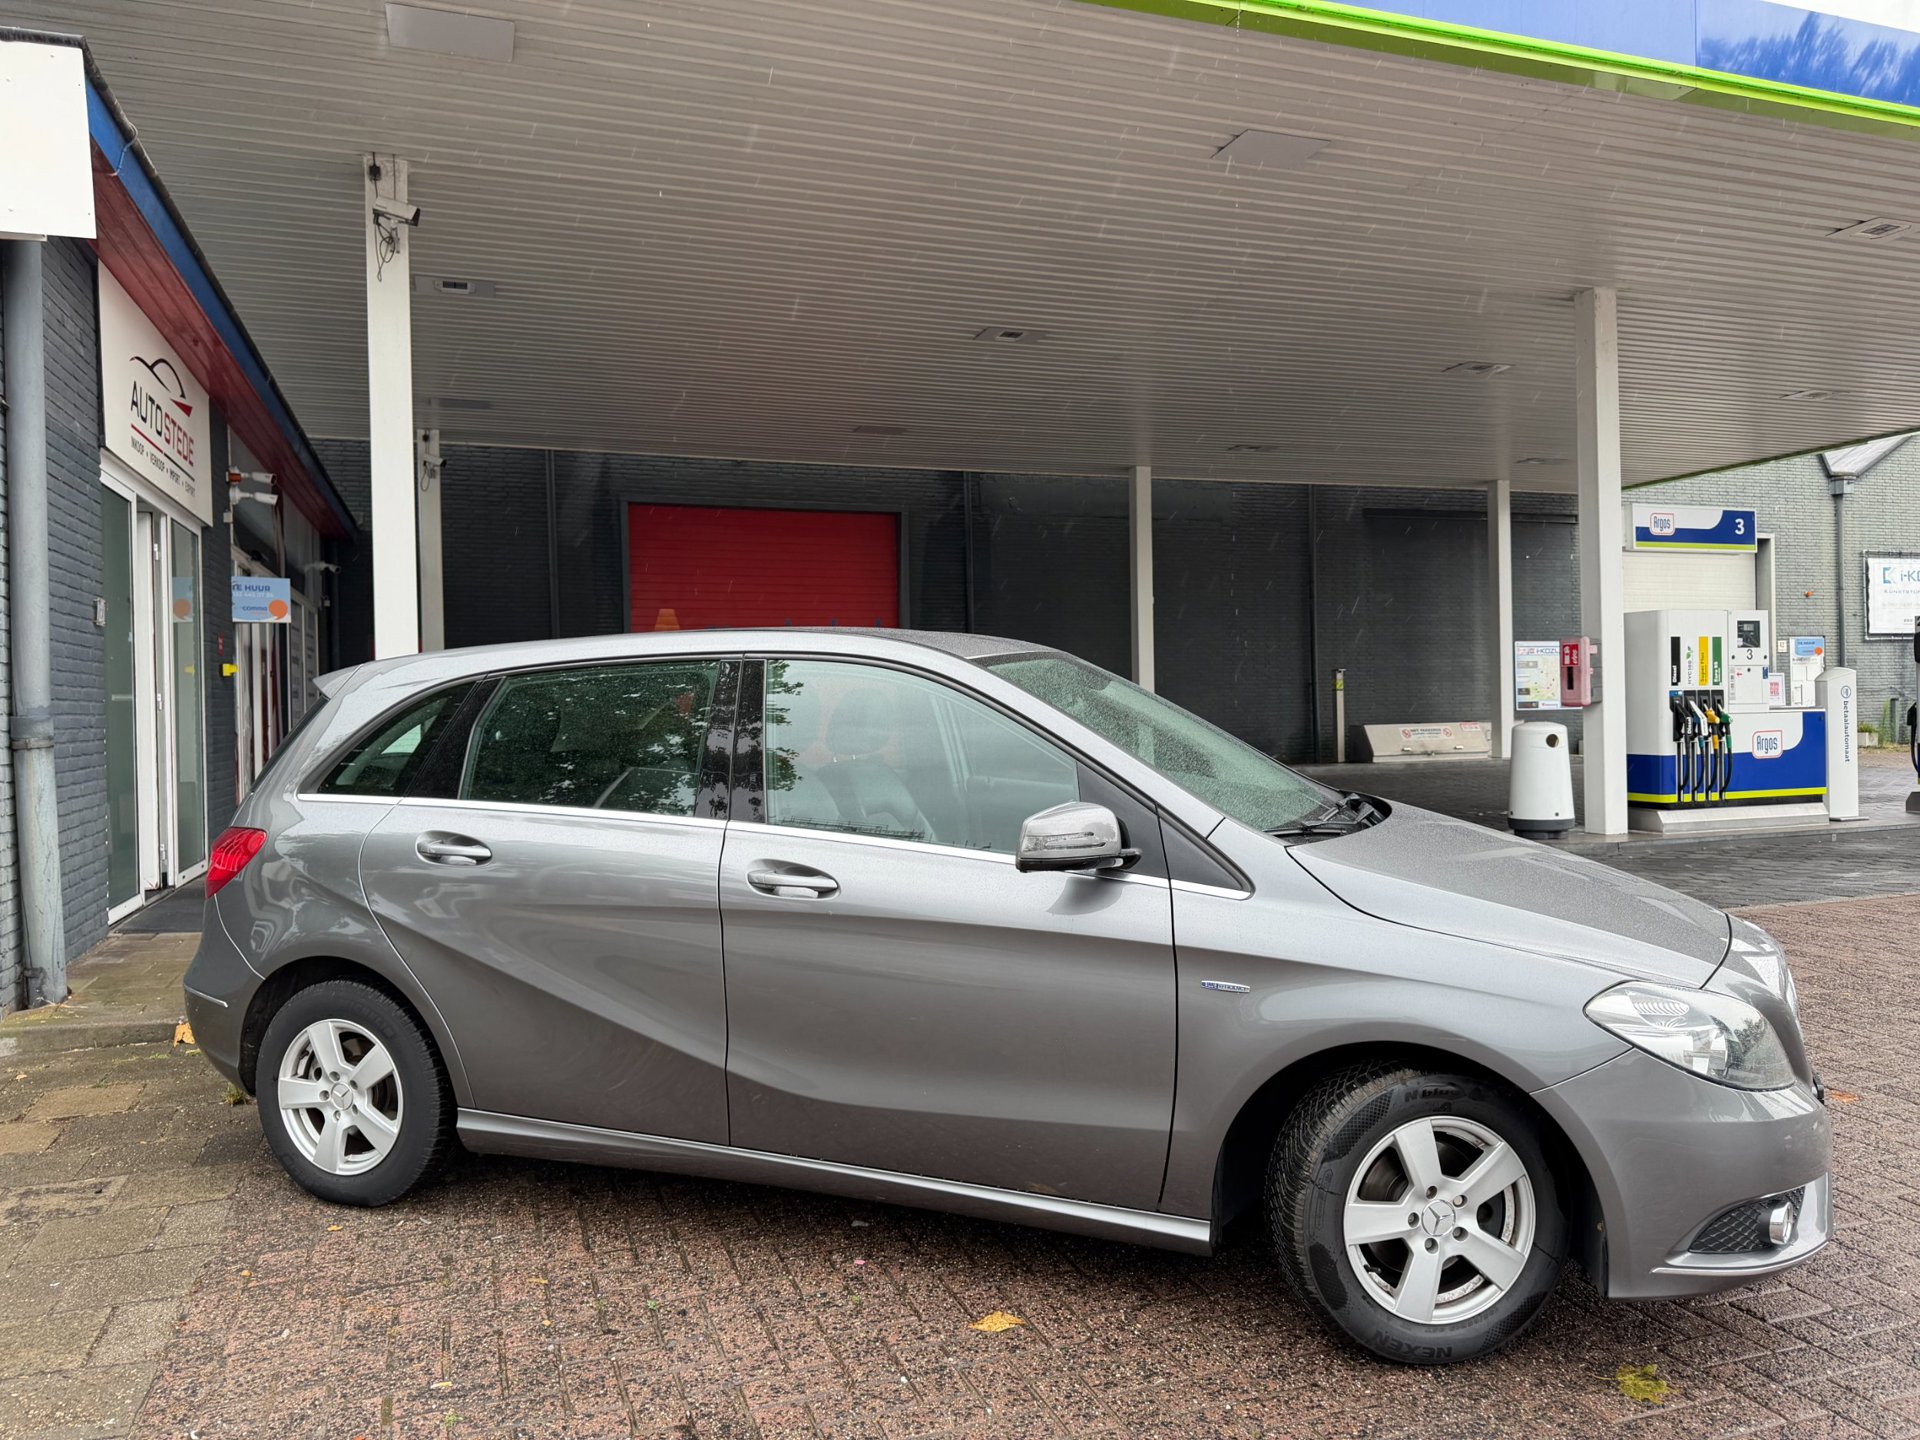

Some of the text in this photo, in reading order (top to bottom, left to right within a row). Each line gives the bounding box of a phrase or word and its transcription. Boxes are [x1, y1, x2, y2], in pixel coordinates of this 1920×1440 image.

[130, 380, 194, 467] AUTOSTEDE
[1653, 516, 1671, 532] Argos
[1734, 518, 1745, 535] 3
[244, 584, 271, 592] HUUR
[1746, 648, 1753, 660] 3
[1756, 735, 1778, 754] Argos
[1375, 1329, 1453, 1358] NEXEN
